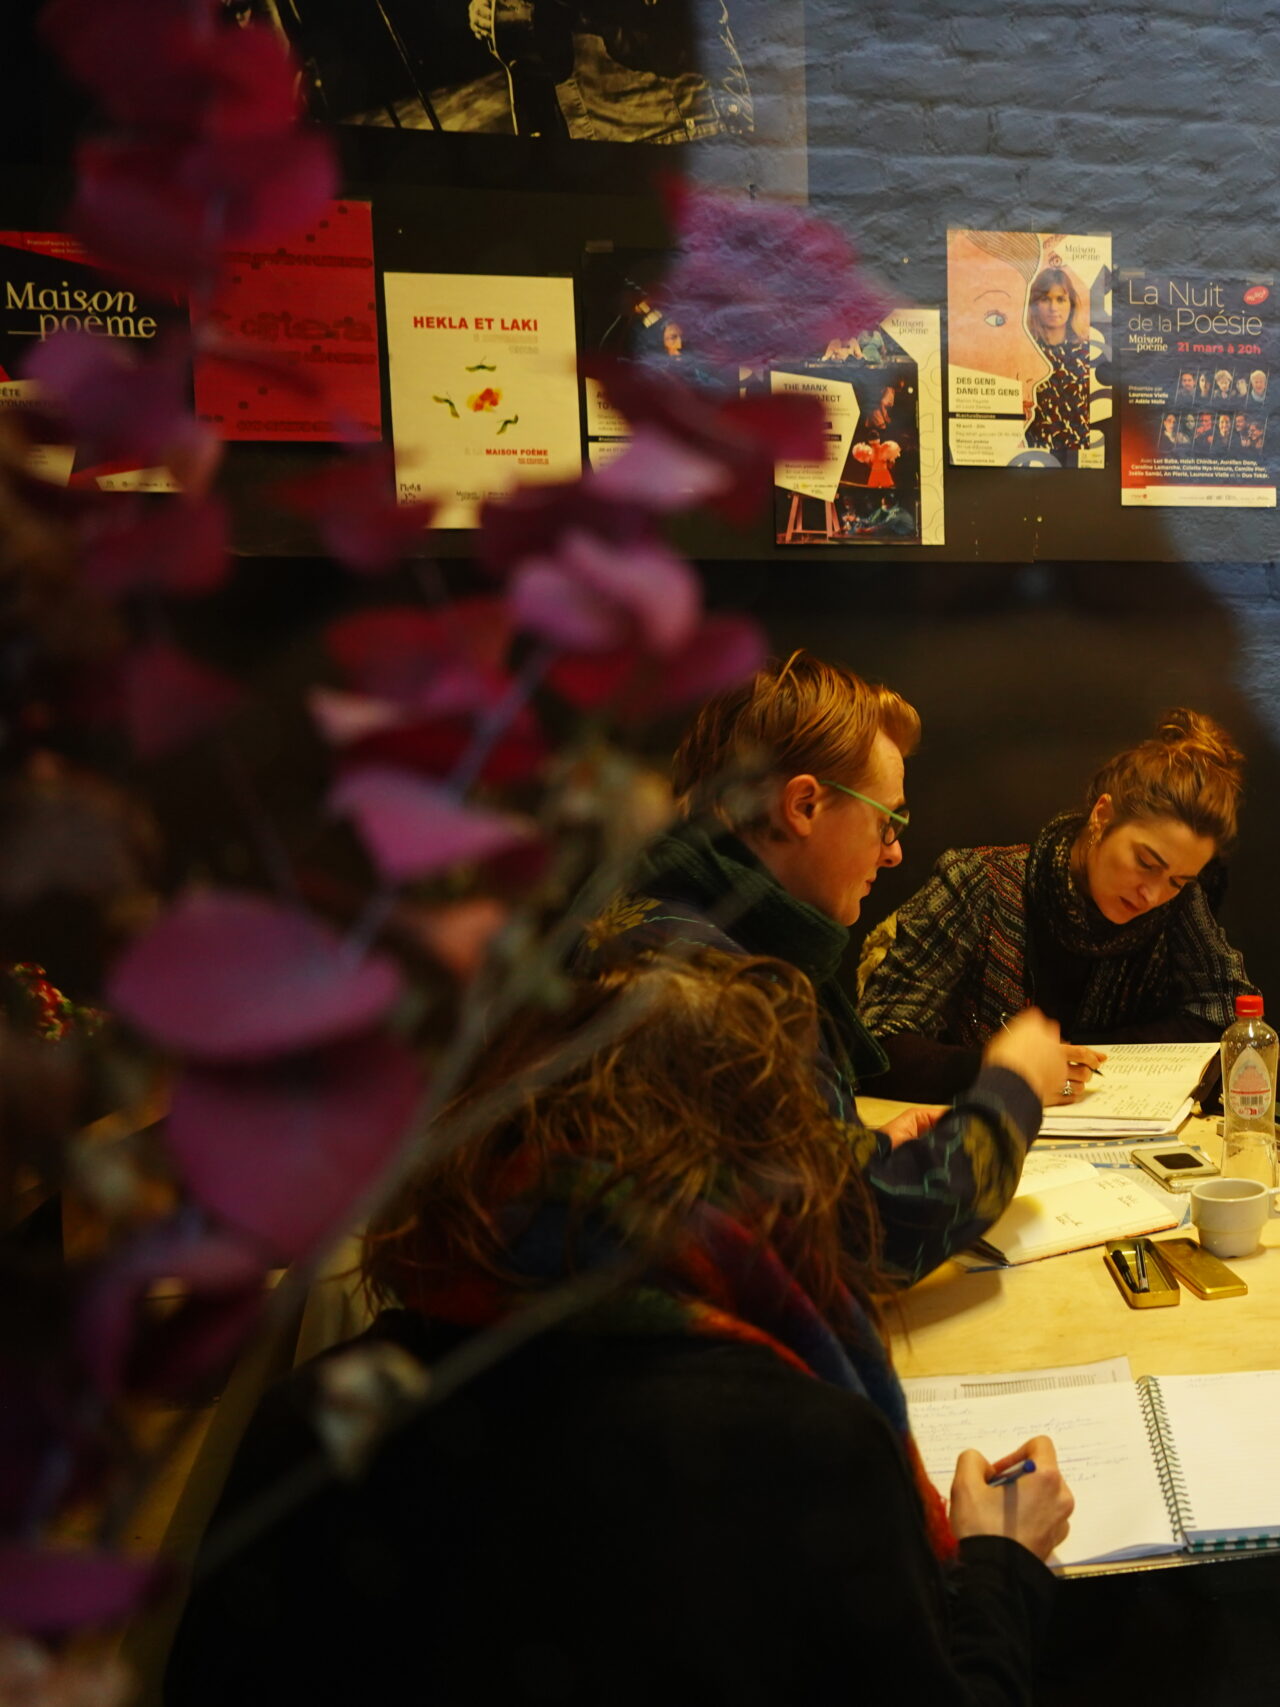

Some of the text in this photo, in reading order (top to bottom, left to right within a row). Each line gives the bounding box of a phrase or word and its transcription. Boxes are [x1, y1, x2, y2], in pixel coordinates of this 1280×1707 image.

[1065, 244, 1096, 253] Maison
[5, 281, 138, 313] Maison
[1129, 280, 1159, 305] La
[1169, 281, 1225, 308] Nuit
[39, 307, 158, 342] poème
[413, 316, 538, 331] HEKLA ET LAKI
[891, 319, 924, 328] Maison
[1128, 308, 1263, 336] de la Poésie
[1128, 334, 1163, 344] Maison
[1136, 342, 1168, 353] poème
[1177, 342, 1262, 355] 21 mars à 20h
[956, 377, 996, 386] DES GENS
[784, 383, 827, 392] THE MANX
[956, 387, 1020, 397] DANS LES GENS
[485, 448, 518, 456] MAISON
